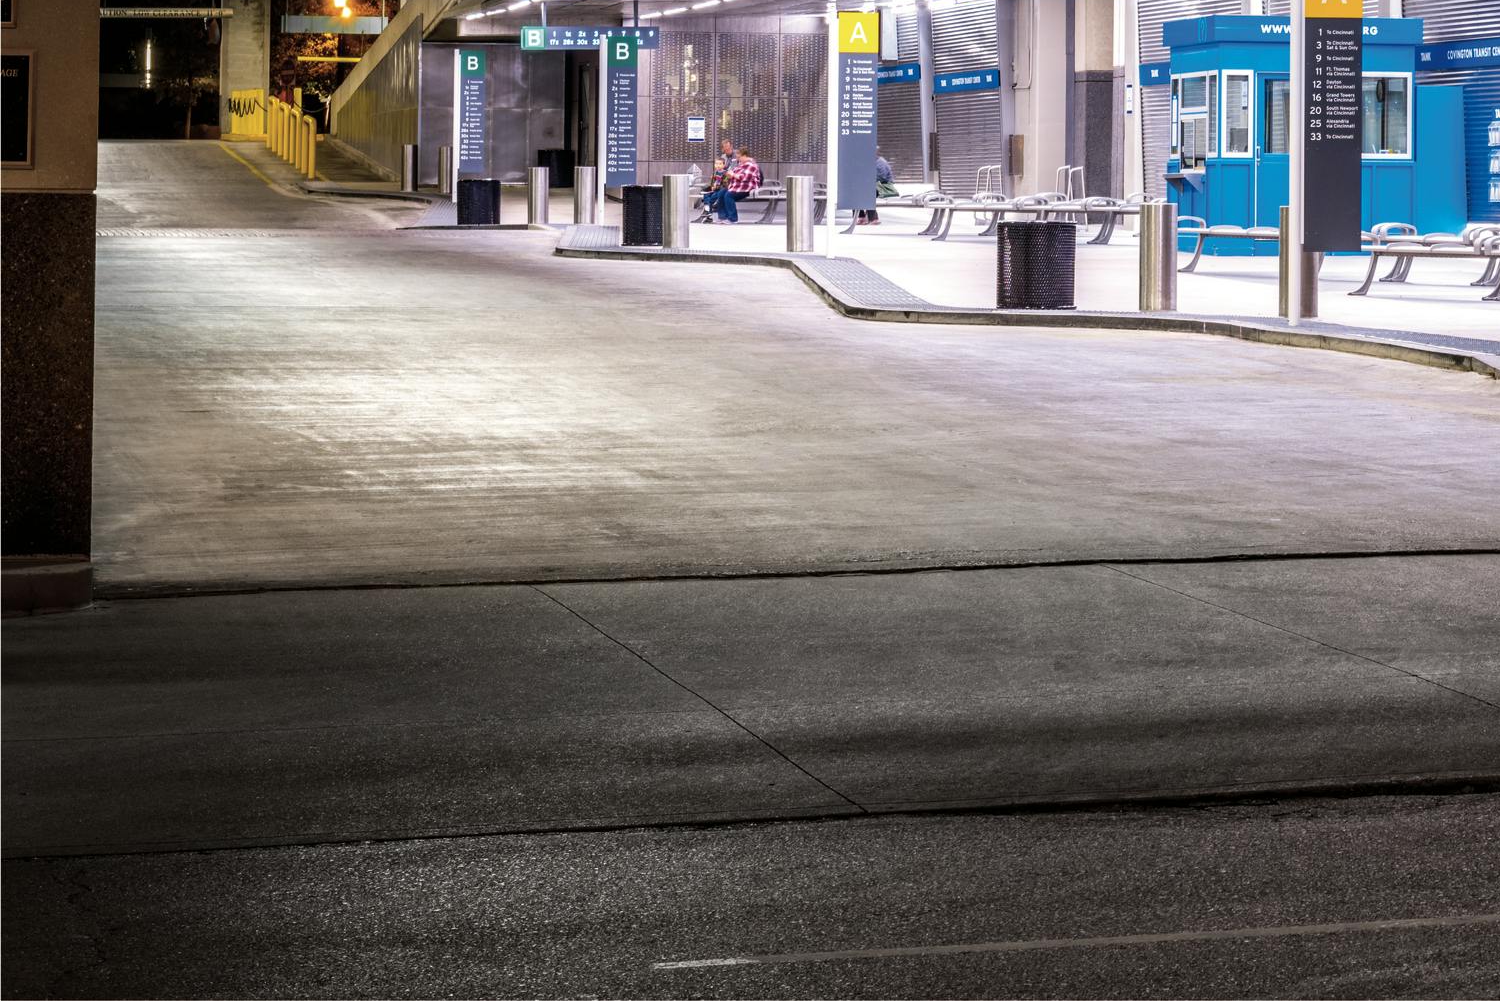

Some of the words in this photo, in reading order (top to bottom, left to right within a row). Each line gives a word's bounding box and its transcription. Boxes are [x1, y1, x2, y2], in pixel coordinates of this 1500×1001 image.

[849, 21, 868, 44] A
[1318, 28, 1322, 36] 1
[528, 30, 540, 46] B
[1316, 41, 1322, 49] 3
[616, 43, 629, 60] B
[1447, 49, 1473, 60] COVINGTON
[1474, 47, 1491, 57] TRANSIT
[1315, 54, 1322, 62] 9
[468, 56, 479, 70] B
[1315, 67, 1322, 75] 11
[1313, 81, 1322, 89] 12
[1312, 93, 1322, 102] 16
[1310, 107, 1322, 115] 20
[1310, 120, 1322, 128] 25
[1310, 133, 1322, 141] 33
